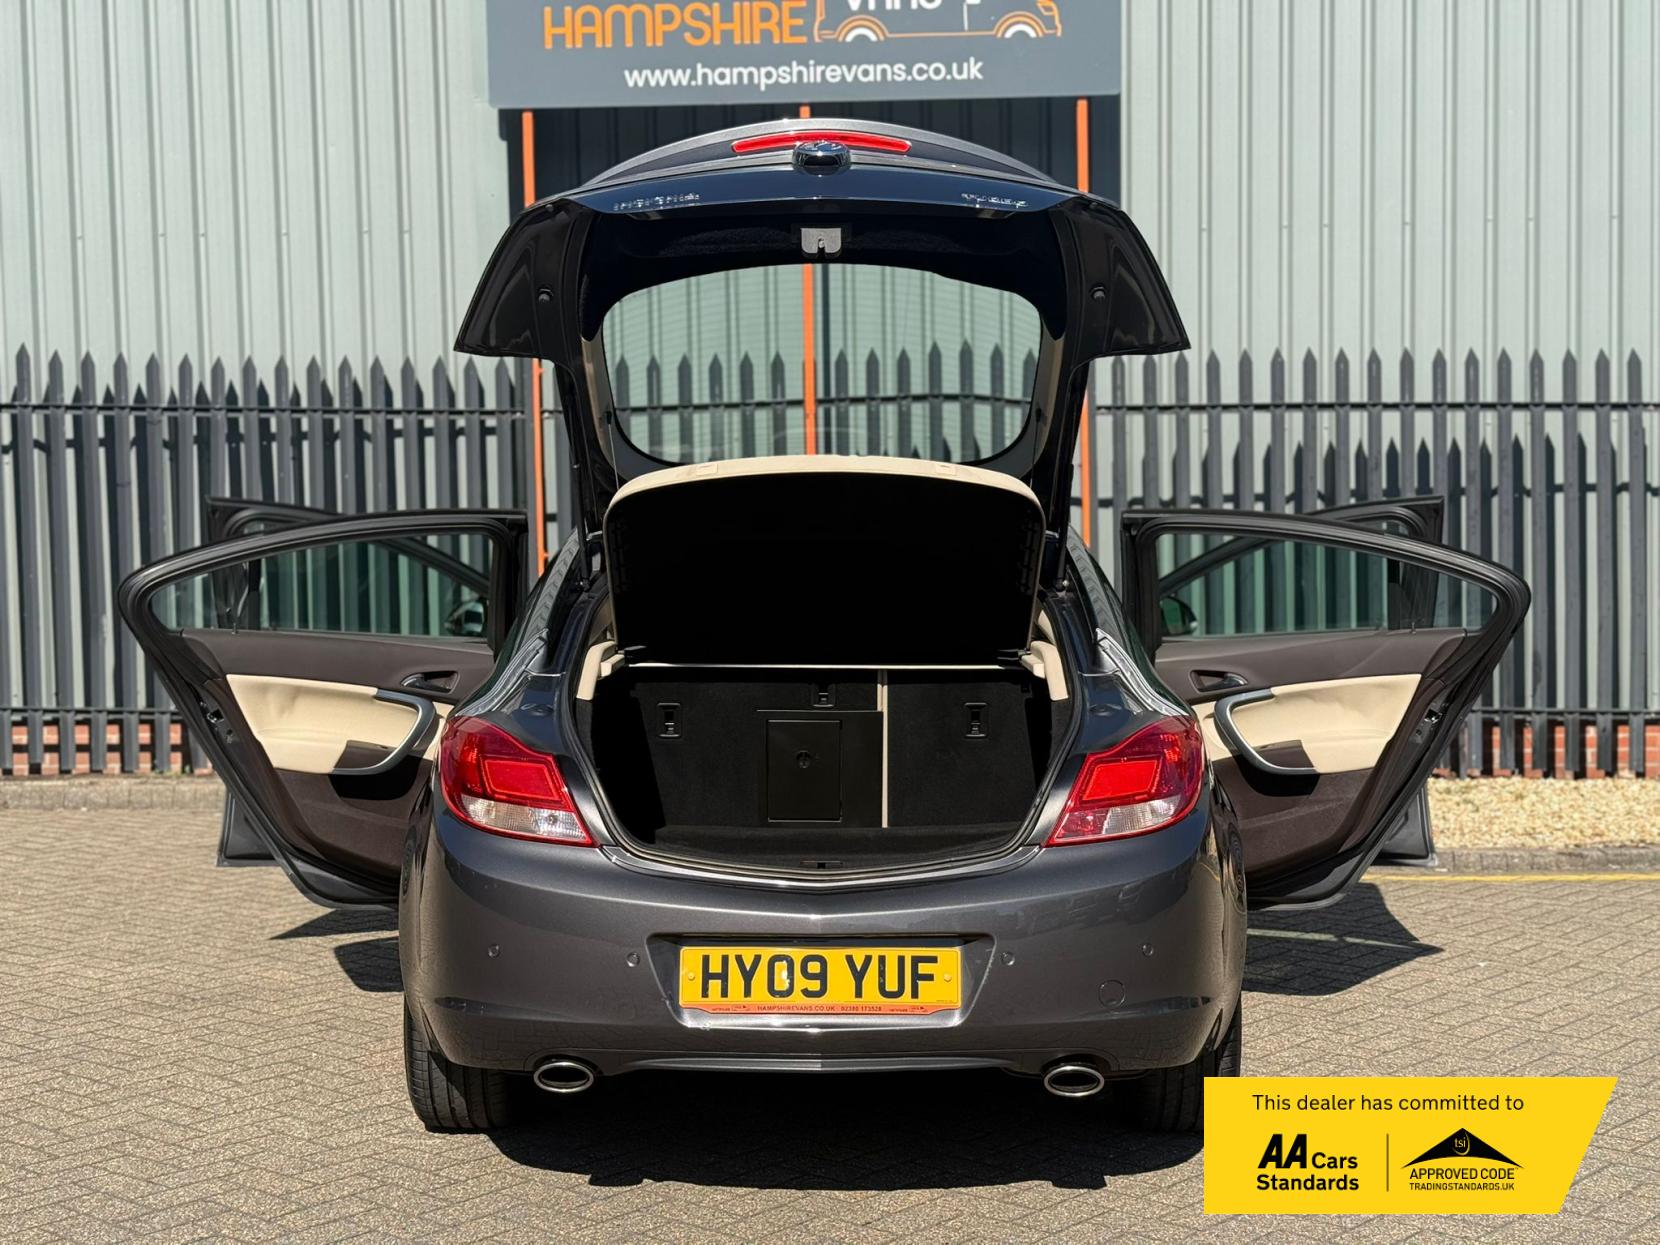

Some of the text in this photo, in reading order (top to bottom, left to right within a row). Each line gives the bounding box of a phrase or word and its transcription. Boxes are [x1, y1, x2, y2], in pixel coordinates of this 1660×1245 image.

[544, 1, 807, 48] HAMPSHIRE
[624, 57, 984, 91] www.hampshirevans.co.uk
[701, 954, 939, 999] HY09 YUF
